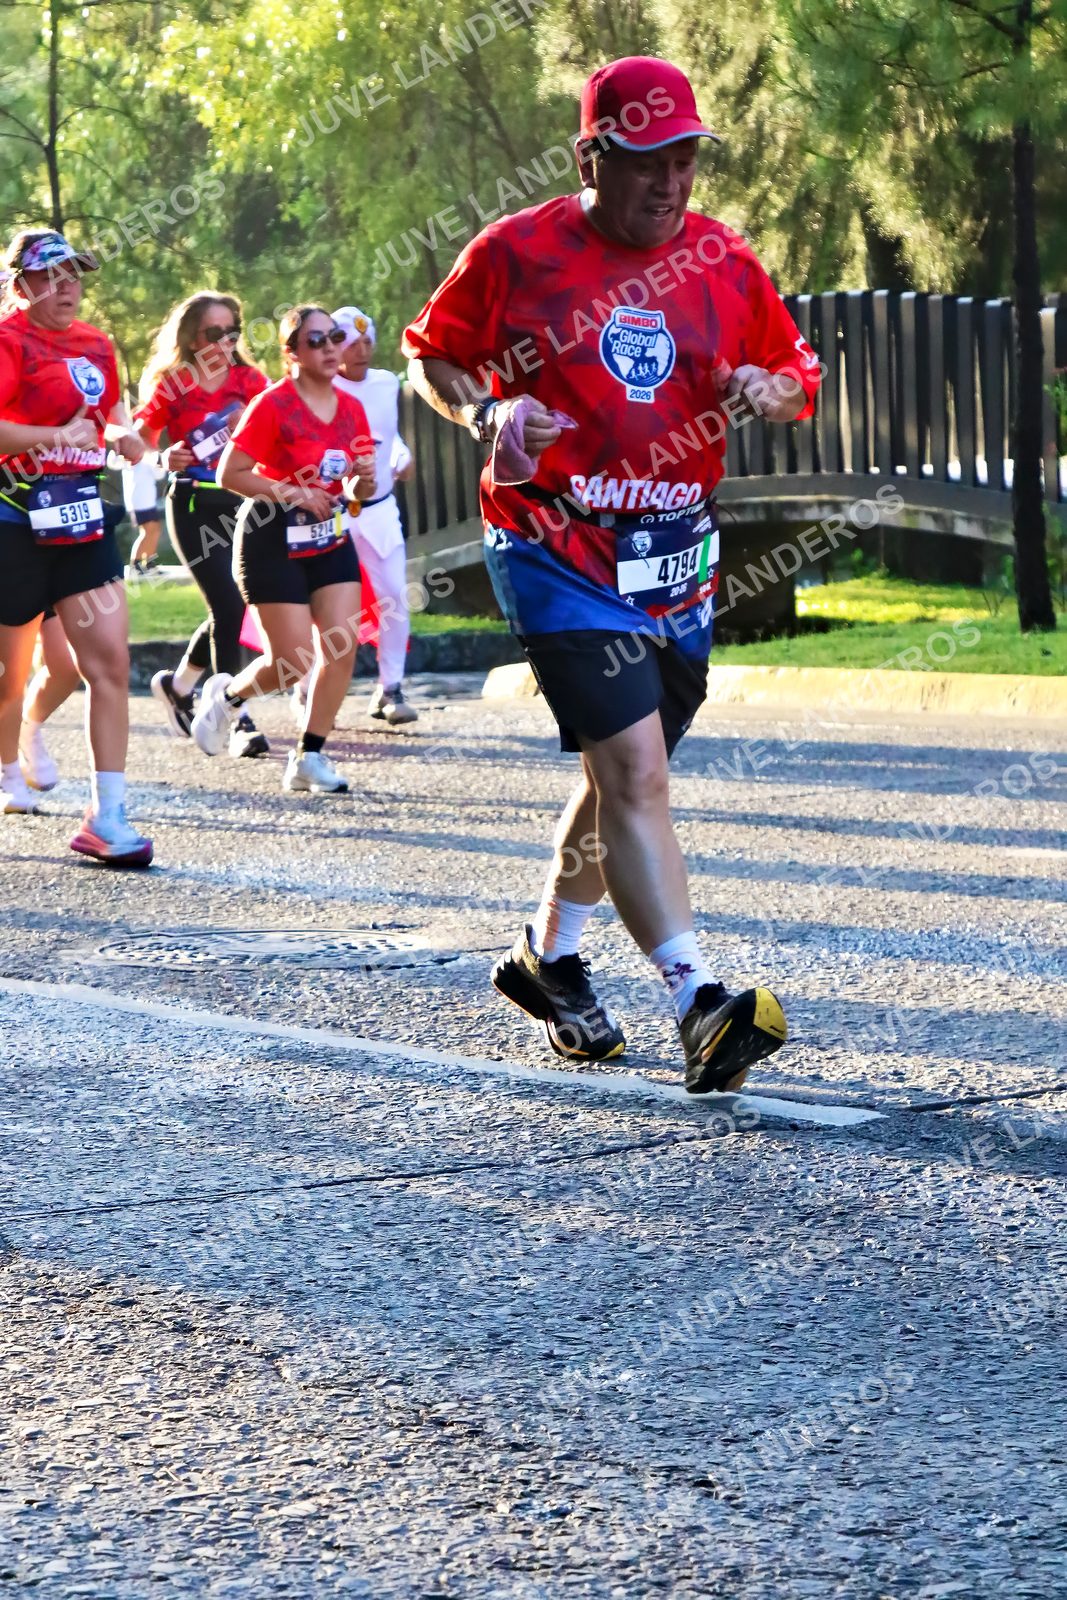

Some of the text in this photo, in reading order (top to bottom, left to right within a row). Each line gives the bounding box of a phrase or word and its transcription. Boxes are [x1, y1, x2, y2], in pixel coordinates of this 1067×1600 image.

[619, 315, 658, 328] BIMBO
[620, 329, 657, 347] Global
[611, 340, 642, 357] Race
[630, 389, 652, 401] 2026
[570, 474, 702, 511] SANTIAGO
[59, 502, 91, 524] 5319
[310, 519, 334, 539] 5214
[657, 547, 698, 584] 4794
